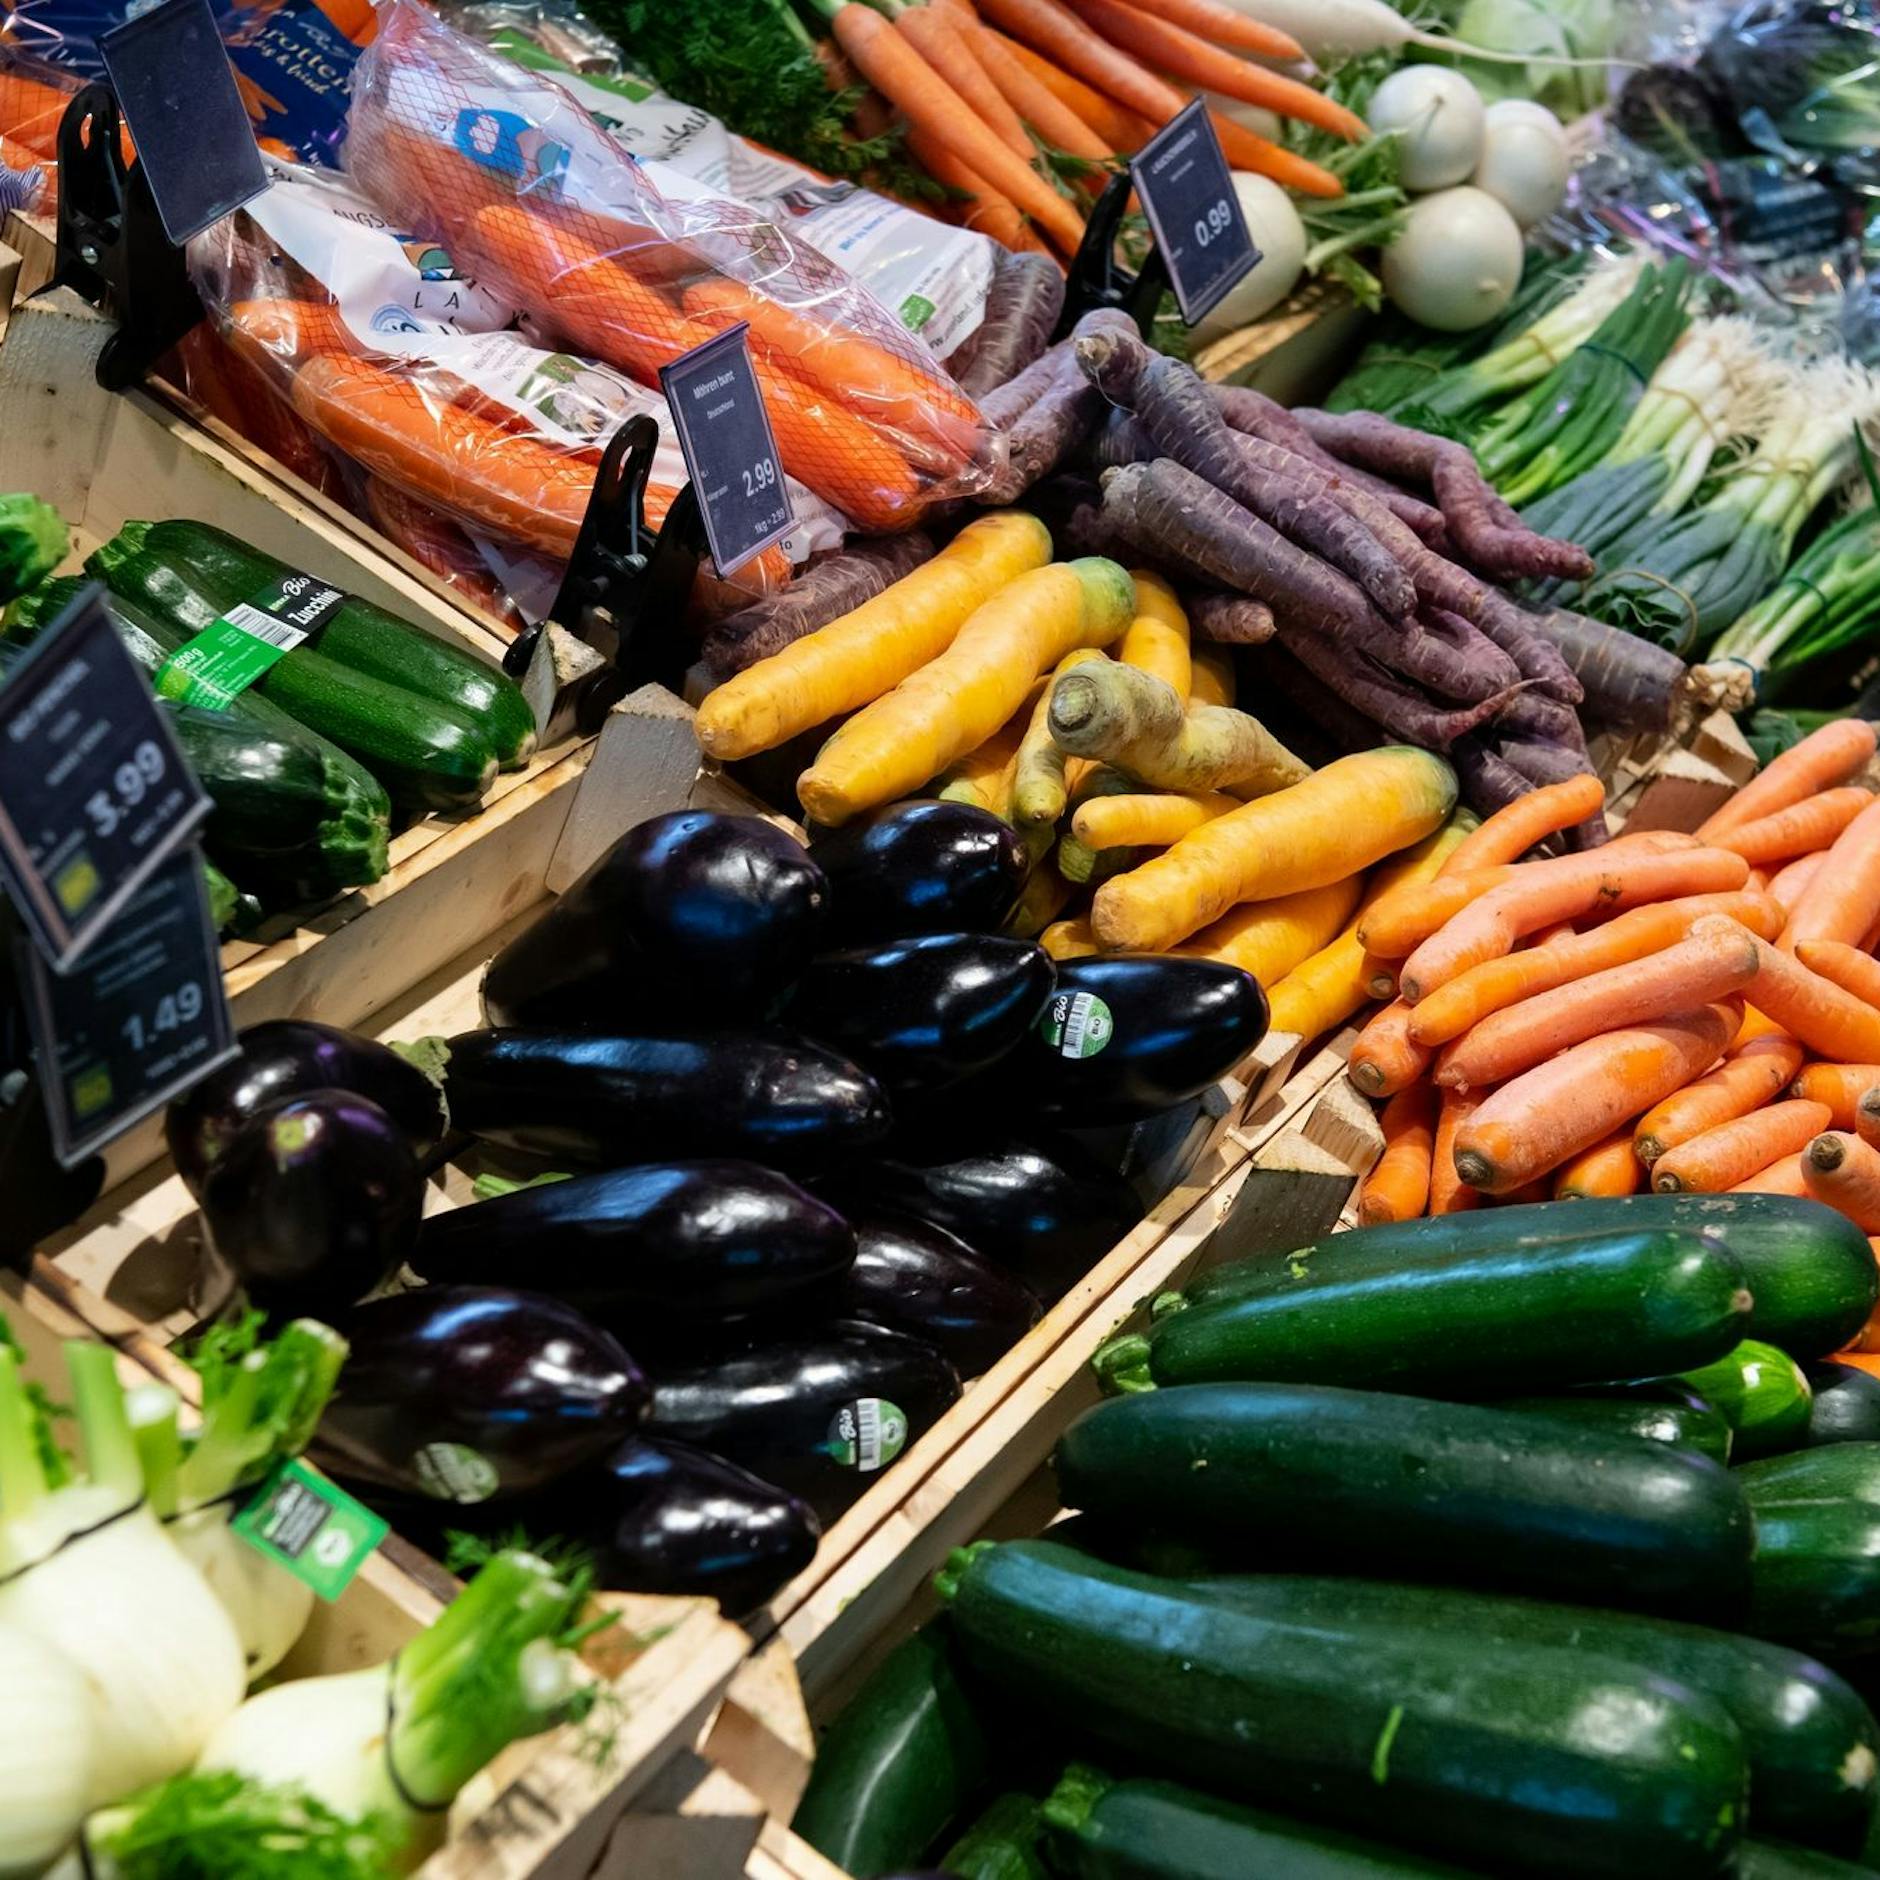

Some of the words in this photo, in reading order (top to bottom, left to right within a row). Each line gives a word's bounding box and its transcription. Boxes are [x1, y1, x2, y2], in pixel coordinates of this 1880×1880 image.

[1194, 199, 1232, 247] 0.99
[693, 377, 720, 399] Möhren
[718, 371, 735, 390] bunt
[742, 458, 775, 497] 2.99
[282, 577, 311, 596] Bio
[288, 588, 343, 625] Zucchini
[120, 981, 203, 1052] 1.49
[1053, 996, 1068, 1023] Bio
[839, 1409, 856, 1441] Bio
